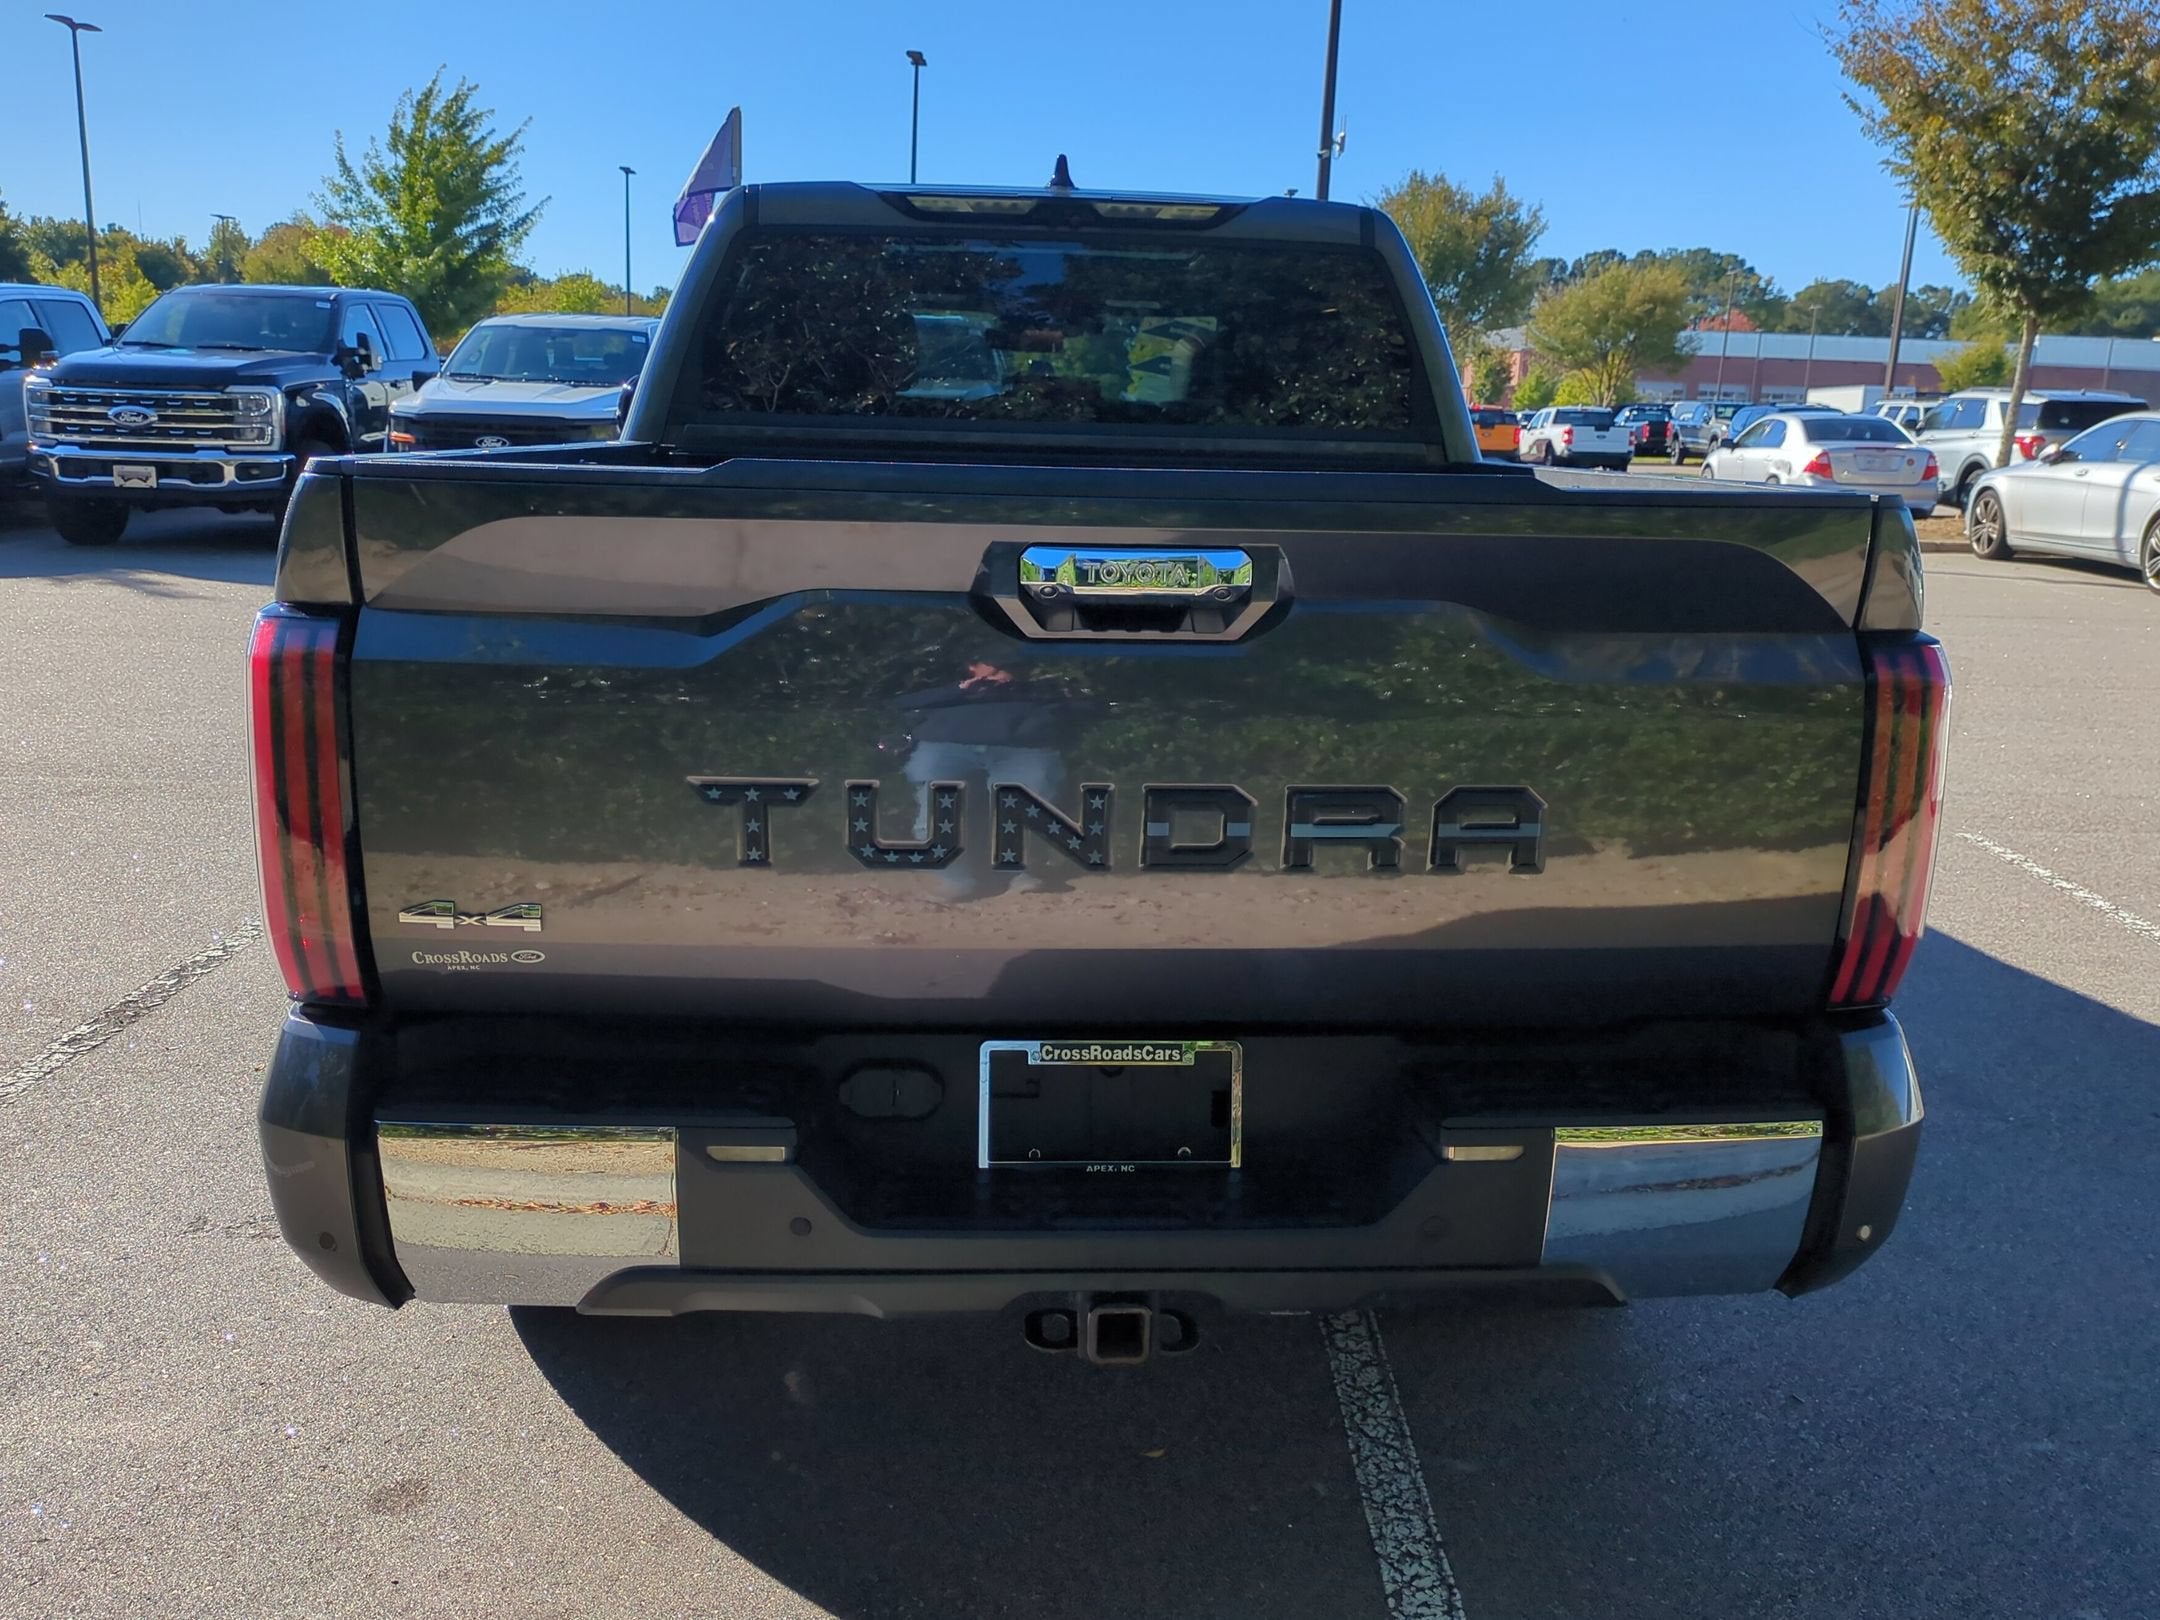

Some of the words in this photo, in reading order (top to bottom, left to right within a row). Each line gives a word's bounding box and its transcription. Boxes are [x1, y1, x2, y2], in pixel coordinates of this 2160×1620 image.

[1083, 560, 1190, 588] TOYOTA
[687, 776, 1549, 873] TUNDRA
[1040, 1044, 1181, 1062] CrossRoadsCars
[1120, 1164, 1136, 1173] NC
